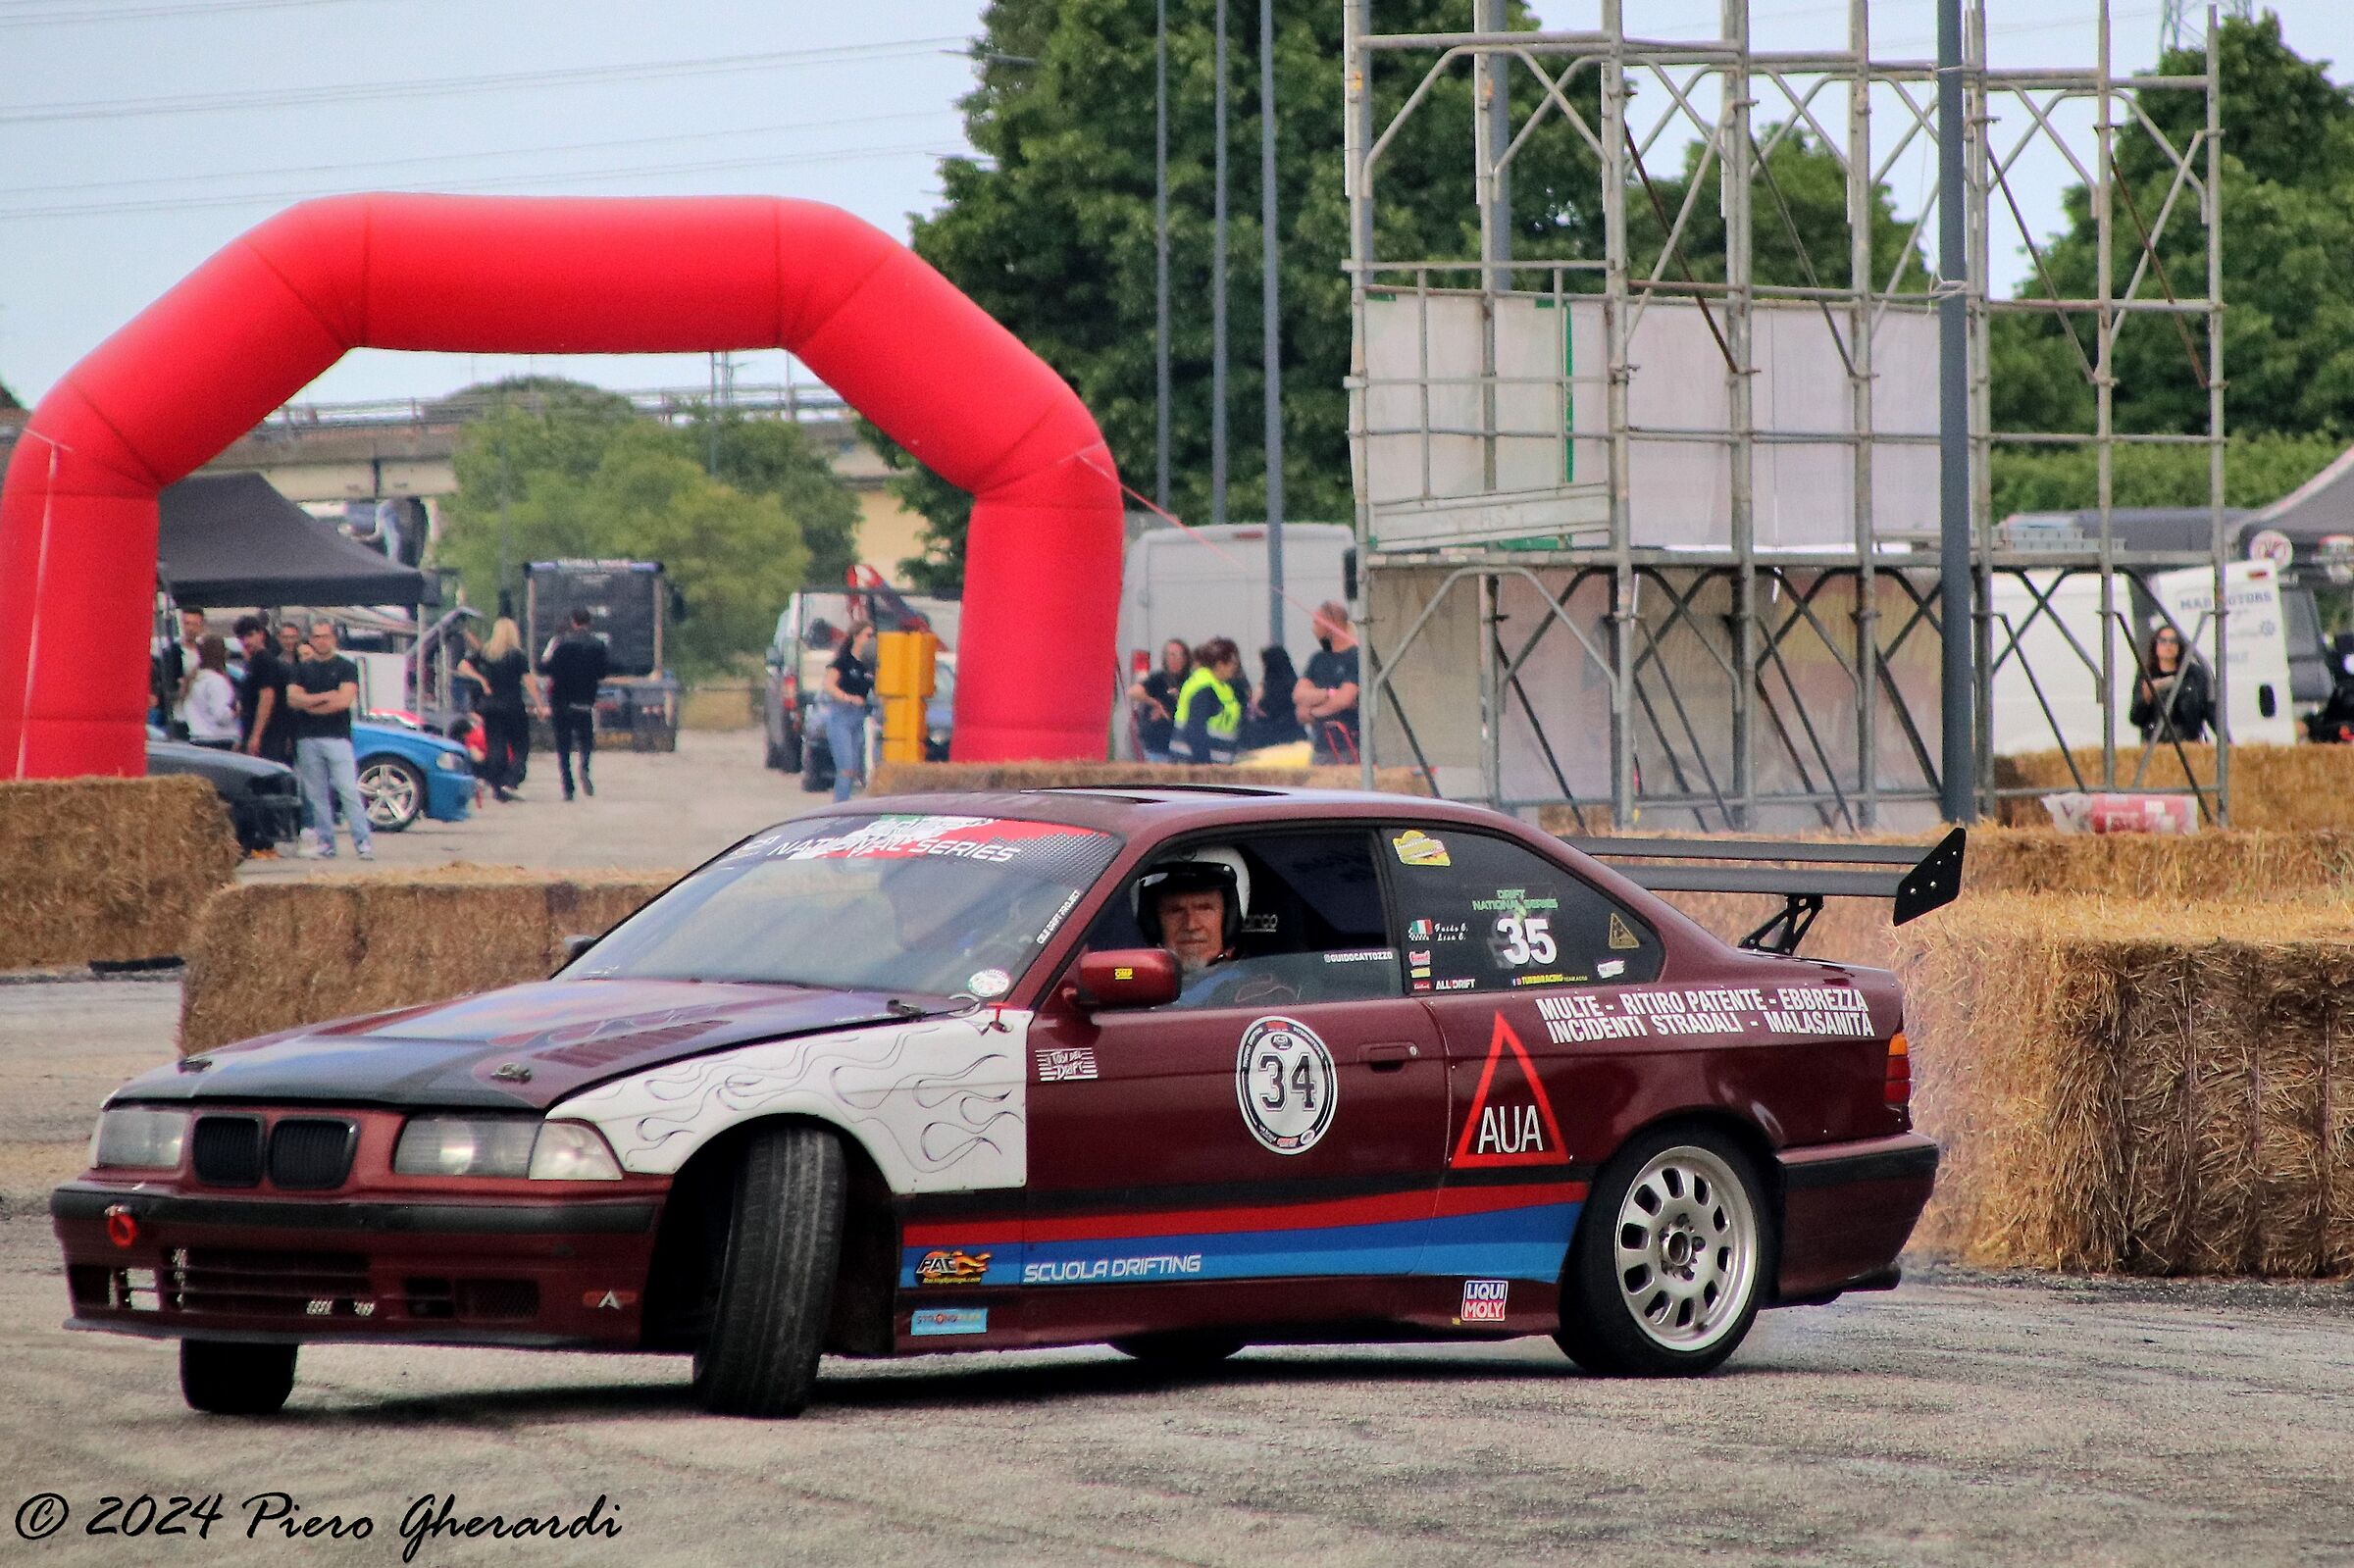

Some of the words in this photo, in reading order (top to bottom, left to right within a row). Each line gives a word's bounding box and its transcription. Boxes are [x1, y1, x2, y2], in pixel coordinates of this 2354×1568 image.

[908, 838, 1022, 862] SERIES
[1497, 918, 1558, 965] 35
[1536, 996, 1605, 1020] MULTE
[1619, 991, 1686, 1015] RITIRO
[1684, 988, 1767, 1012] PATENTE
[1777, 988, 1869, 1012] EBBREZZA
[1546, 1016, 1648, 1044] INCIDENTI
[1650, 1011, 1744, 1036] STRADALI
[1258, 1052, 1317, 1112] 34
[1477, 1105, 1544, 1154] AUA
[1023, 1260, 1109, 1284] SCUOLA
[1111, 1253, 1203, 1278] DRIFTING
[1466, 1283, 1506, 1301] LIQUI
[1463, 1301, 1505, 1318] MOLY
